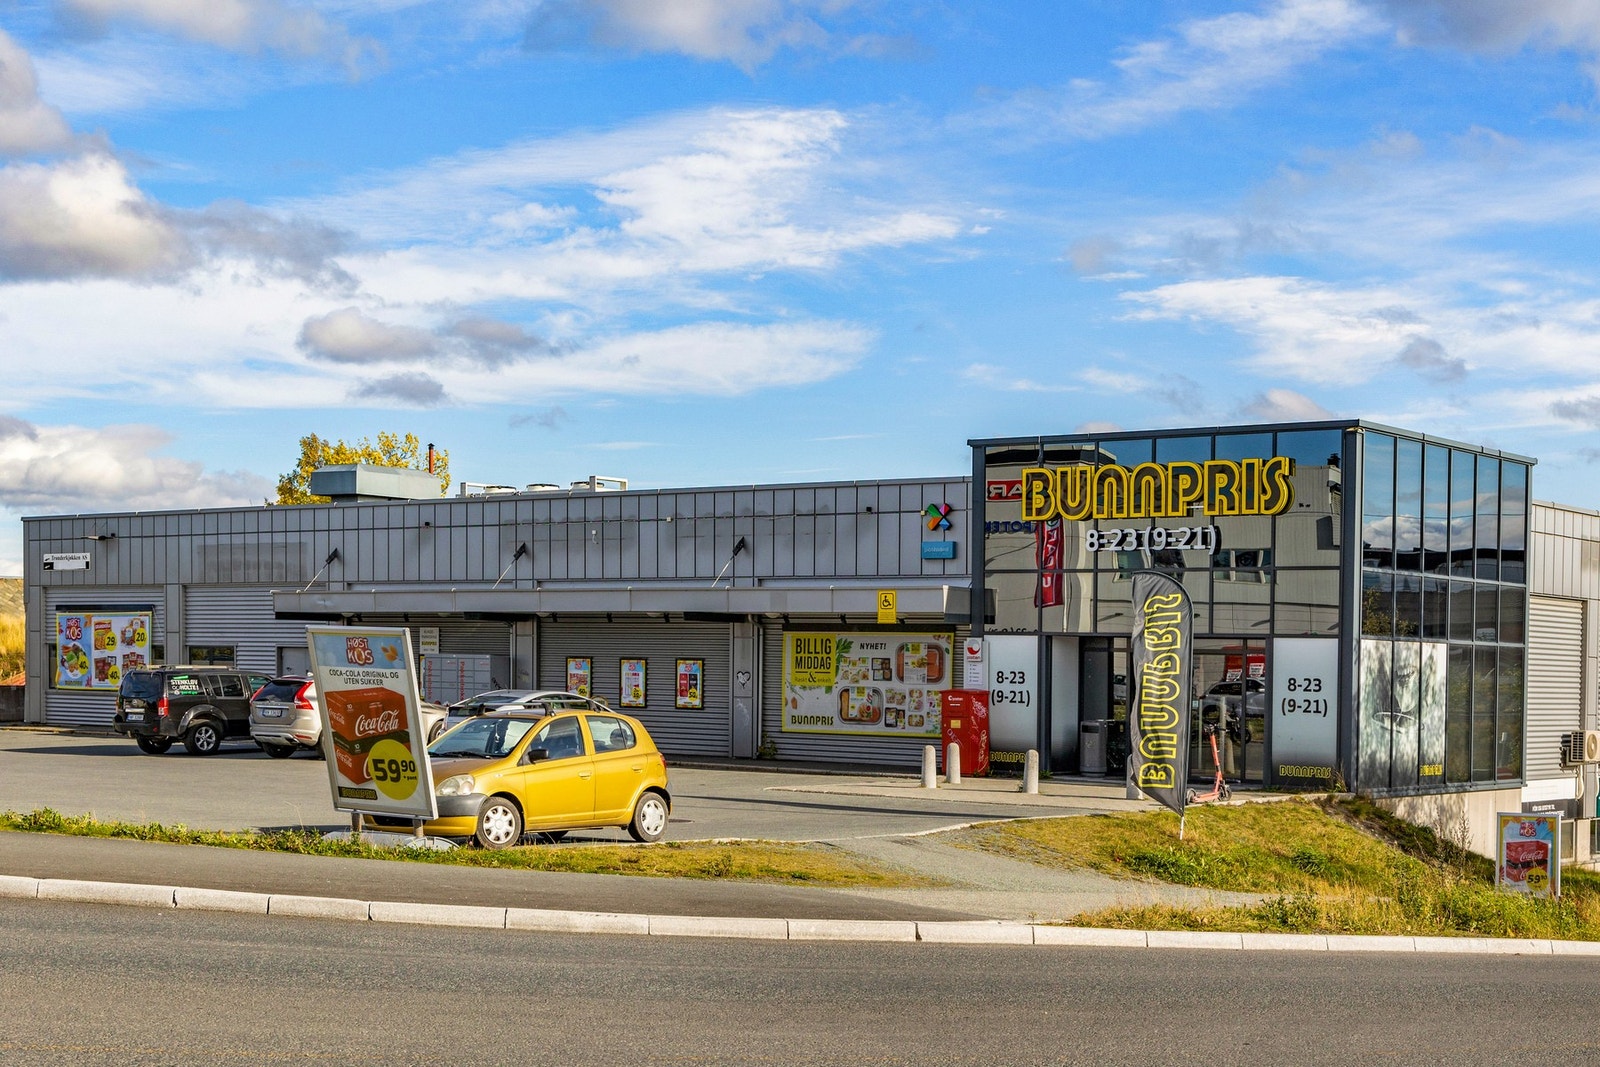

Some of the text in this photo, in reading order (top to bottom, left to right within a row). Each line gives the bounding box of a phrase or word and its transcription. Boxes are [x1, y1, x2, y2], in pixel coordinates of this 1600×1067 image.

[1022, 457, 1295, 521] BUNNPRIS
[1086, 524, 1218, 556] 8-23 (9-21)
[346, 638, 368, 649] HØST
[795, 638, 831, 655] BILLIG
[860, 642, 887, 650] NYHET!
[347, 648, 373, 664] KOS
[794, 656, 831, 670] MIDDAG
[329, 669, 361, 678] COCA-COLA
[362, 671, 389, 679] ORIGINAL
[996, 671, 1026, 684] 8-23
[360, 678, 384, 686] SUKKER
[1287, 677, 1322, 692] 8-23
[991, 689, 1031, 707] (9-21)
[1281, 698, 1328, 717] (9-21)
[355, 709, 400, 737] Coca-Cola
[791, 714, 834, 726] BUNNPRIS
[990, 751, 1026, 763] BUNNPR
[1279, 764, 1331, 778] BUNNPRIS
